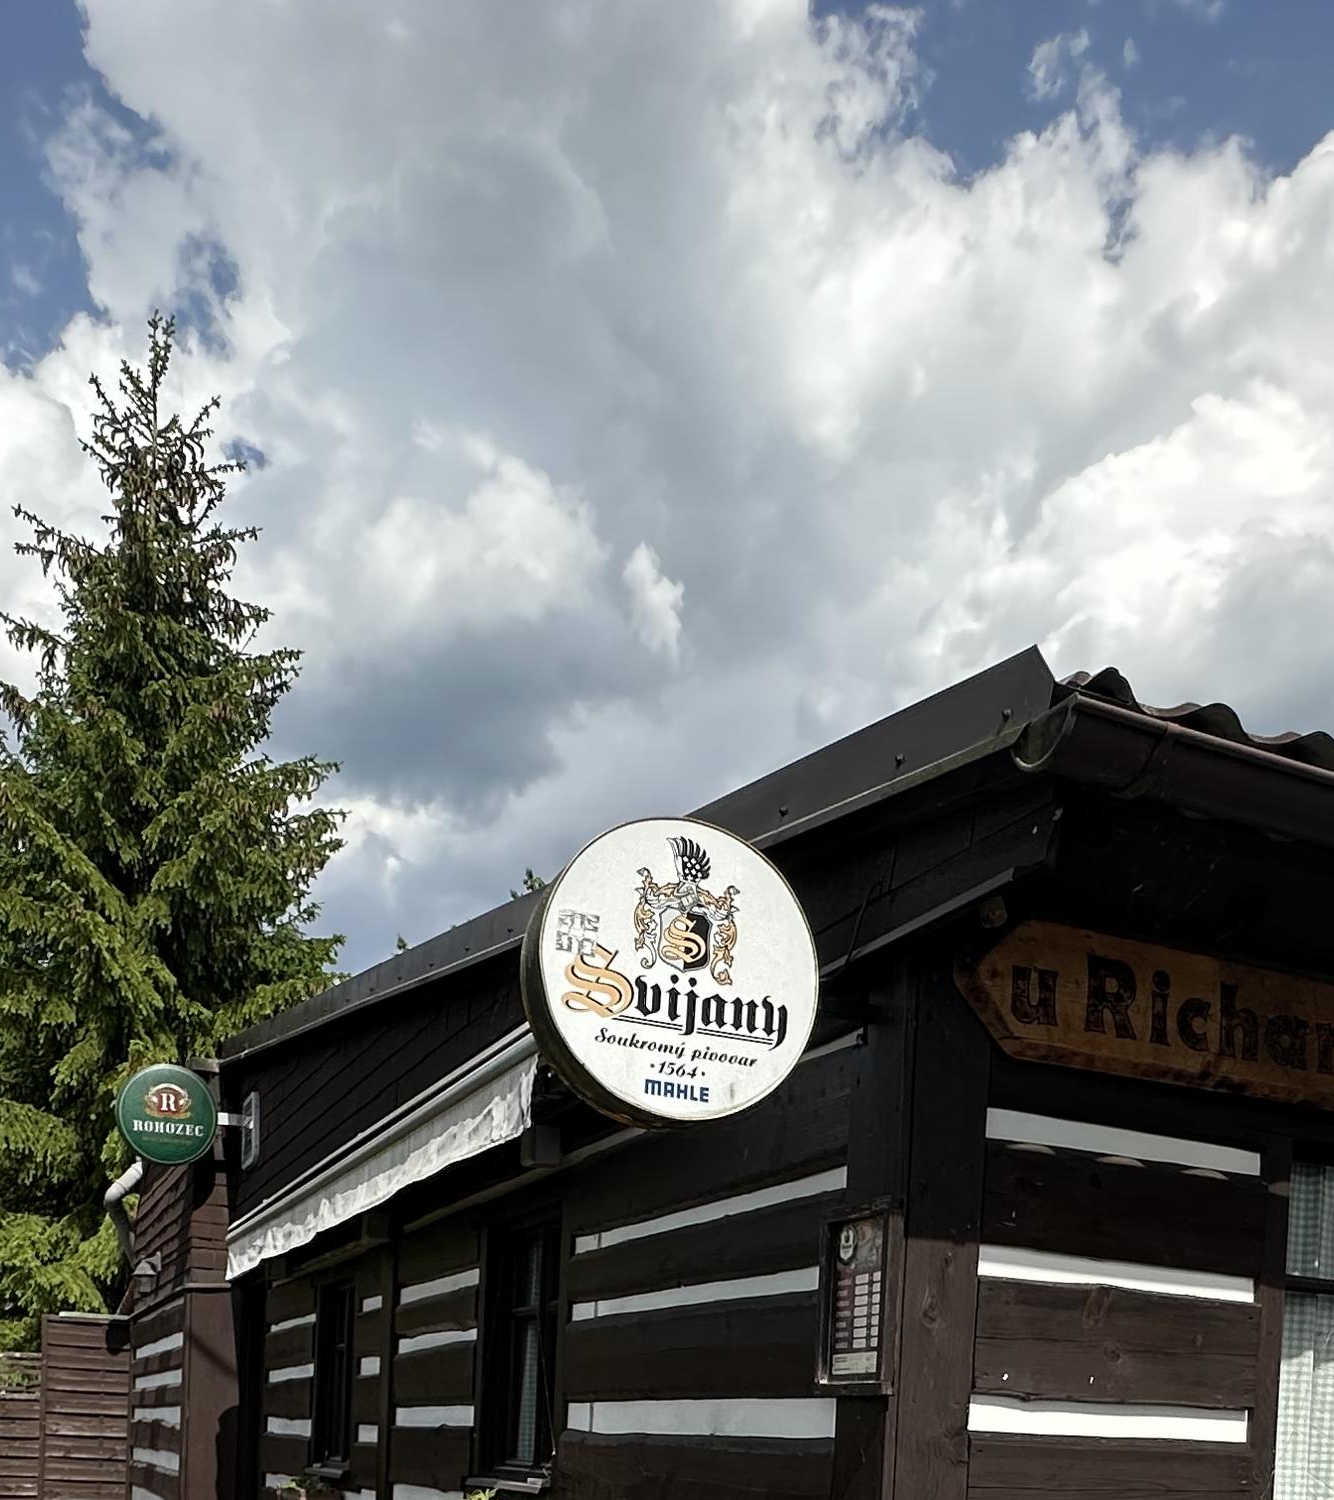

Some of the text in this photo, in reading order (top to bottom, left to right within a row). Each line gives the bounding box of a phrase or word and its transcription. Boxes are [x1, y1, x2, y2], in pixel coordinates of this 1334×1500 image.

[661, 914, 706, 963] S
[561, 943, 788, 1051] Svijany
[594, 1027, 758, 1067] Soukromý pivovar
[160, 1093, 177, 1112] R
[644, 1079, 709, 1103] MAHLE
[132, 1119, 204, 1137] ROHOZEC
